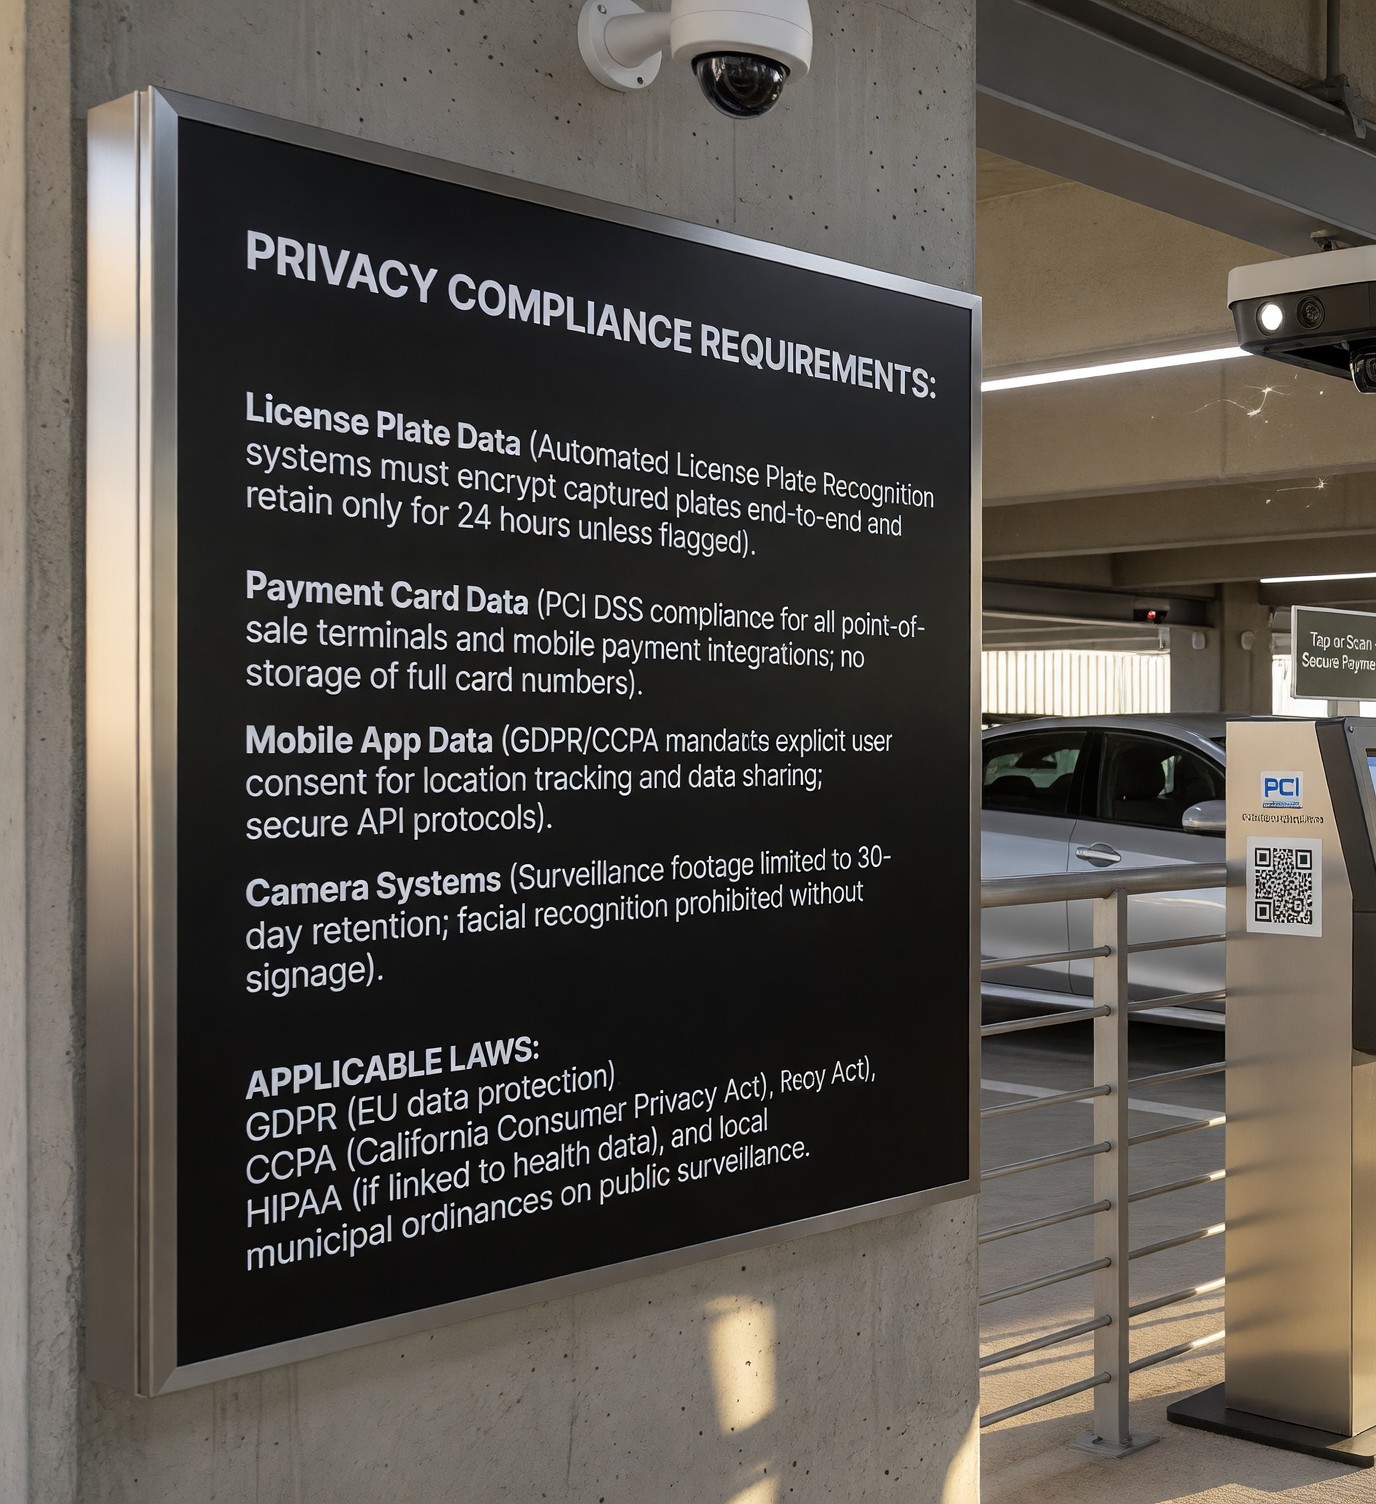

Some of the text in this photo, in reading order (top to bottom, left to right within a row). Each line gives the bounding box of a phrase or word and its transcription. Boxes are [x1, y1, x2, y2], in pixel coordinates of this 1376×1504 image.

[246, 229, 937, 400] PRIVACY COMPLIANCE REQUIREMENTS:
[246, 391, 934, 509] License Plate Data (Automated License Plate Recognition
[245, 442, 902, 537] systems must encrypt captured plates end-to-end and
[246, 484, 756, 559] retain only for 24 hours unless flagged).
[246, 569, 926, 640] Payment Card Data (PCI DSS compliance for all point-of-
[245, 615, 865, 672] sale terminals and mobile payment integrations; no
[1302, 651, 1340, 669] Secure
[1310, 631, 1331, 651] Tap
[1333, 637, 1345, 648] or
[1346, 634, 1372, 650] Scan
[245, 659, 643, 700] storage of full card numbers).
[246, 724, 354, 754] Mobile
[360, 725, 422, 761] App
[428, 726, 493, 754] Data
[502, 723, 659, 757] (GDPR/CCPA
[775, 727, 847, 758] explicit
[852, 733, 893, 752] user
[245, 762, 823, 798] consent for location tracking and data sharing;
[1264, 777, 1299, 798] PCI
[245, 801, 553, 841] secure API protocols).
[245, 844, 892, 908] Camera Systems (Surveillance footage limited to 30-
[245, 880, 864, 955] day retention; facial recognition prohibited without
[245, 951, 383, 998] signage).
[245, 1035, 540, 1100] APPLICABLE LAWS:
[246, 1059, 615, 1142] GDPR (EU data protection)
[246, 1144, 337, 1185] CCPA
[347, 1120, 489, 1172] (California
[497, 1101, 628, 1142] Consumer
[634, 1086, 718, 1119] Privacy
[723, 1071, 774, 1104] Act),
[830, 1054, 876, 1085] Act),
[247, 1106, 768, 1228] HIPAA (if linked to health data), and local
[246, 1140, 810, 1272] municipal ordinances on public surveillance.
